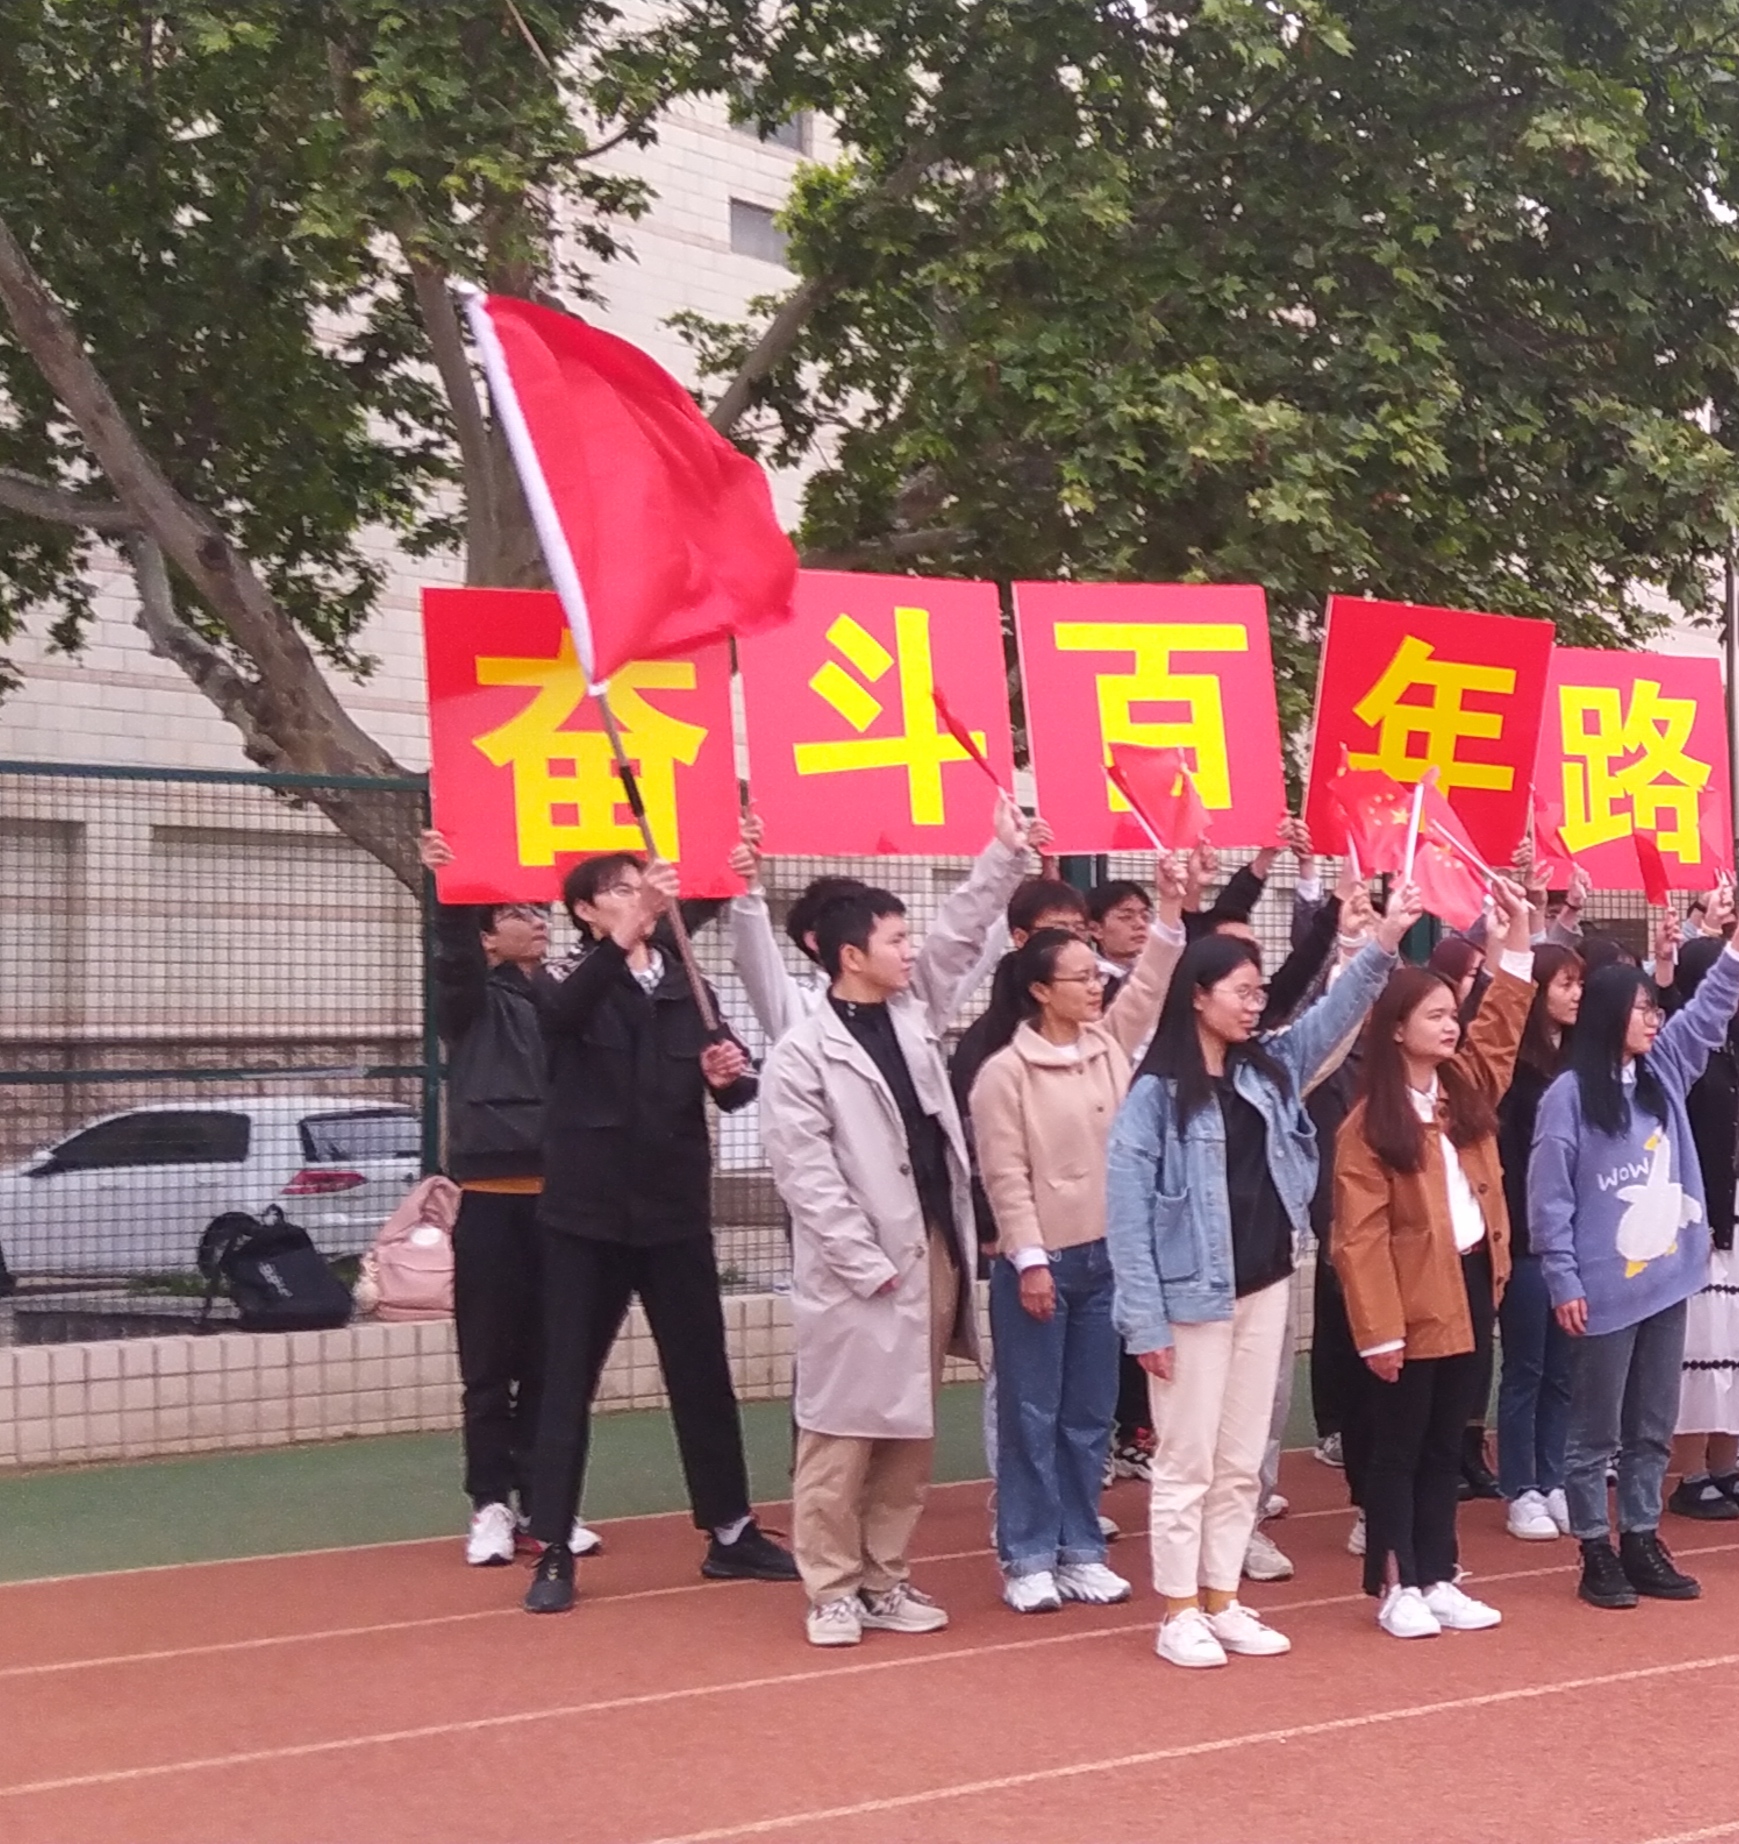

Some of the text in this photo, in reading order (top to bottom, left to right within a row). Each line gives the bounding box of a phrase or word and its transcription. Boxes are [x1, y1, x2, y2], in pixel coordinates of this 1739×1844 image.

[473, 627, 707, 866] 奋
[793, 607, 987, 825] 斗
[1054, 622, 1248, 811] 百
[1348, 634, 1517, 833] 年
[1559, 679, 1712, 864] 路
